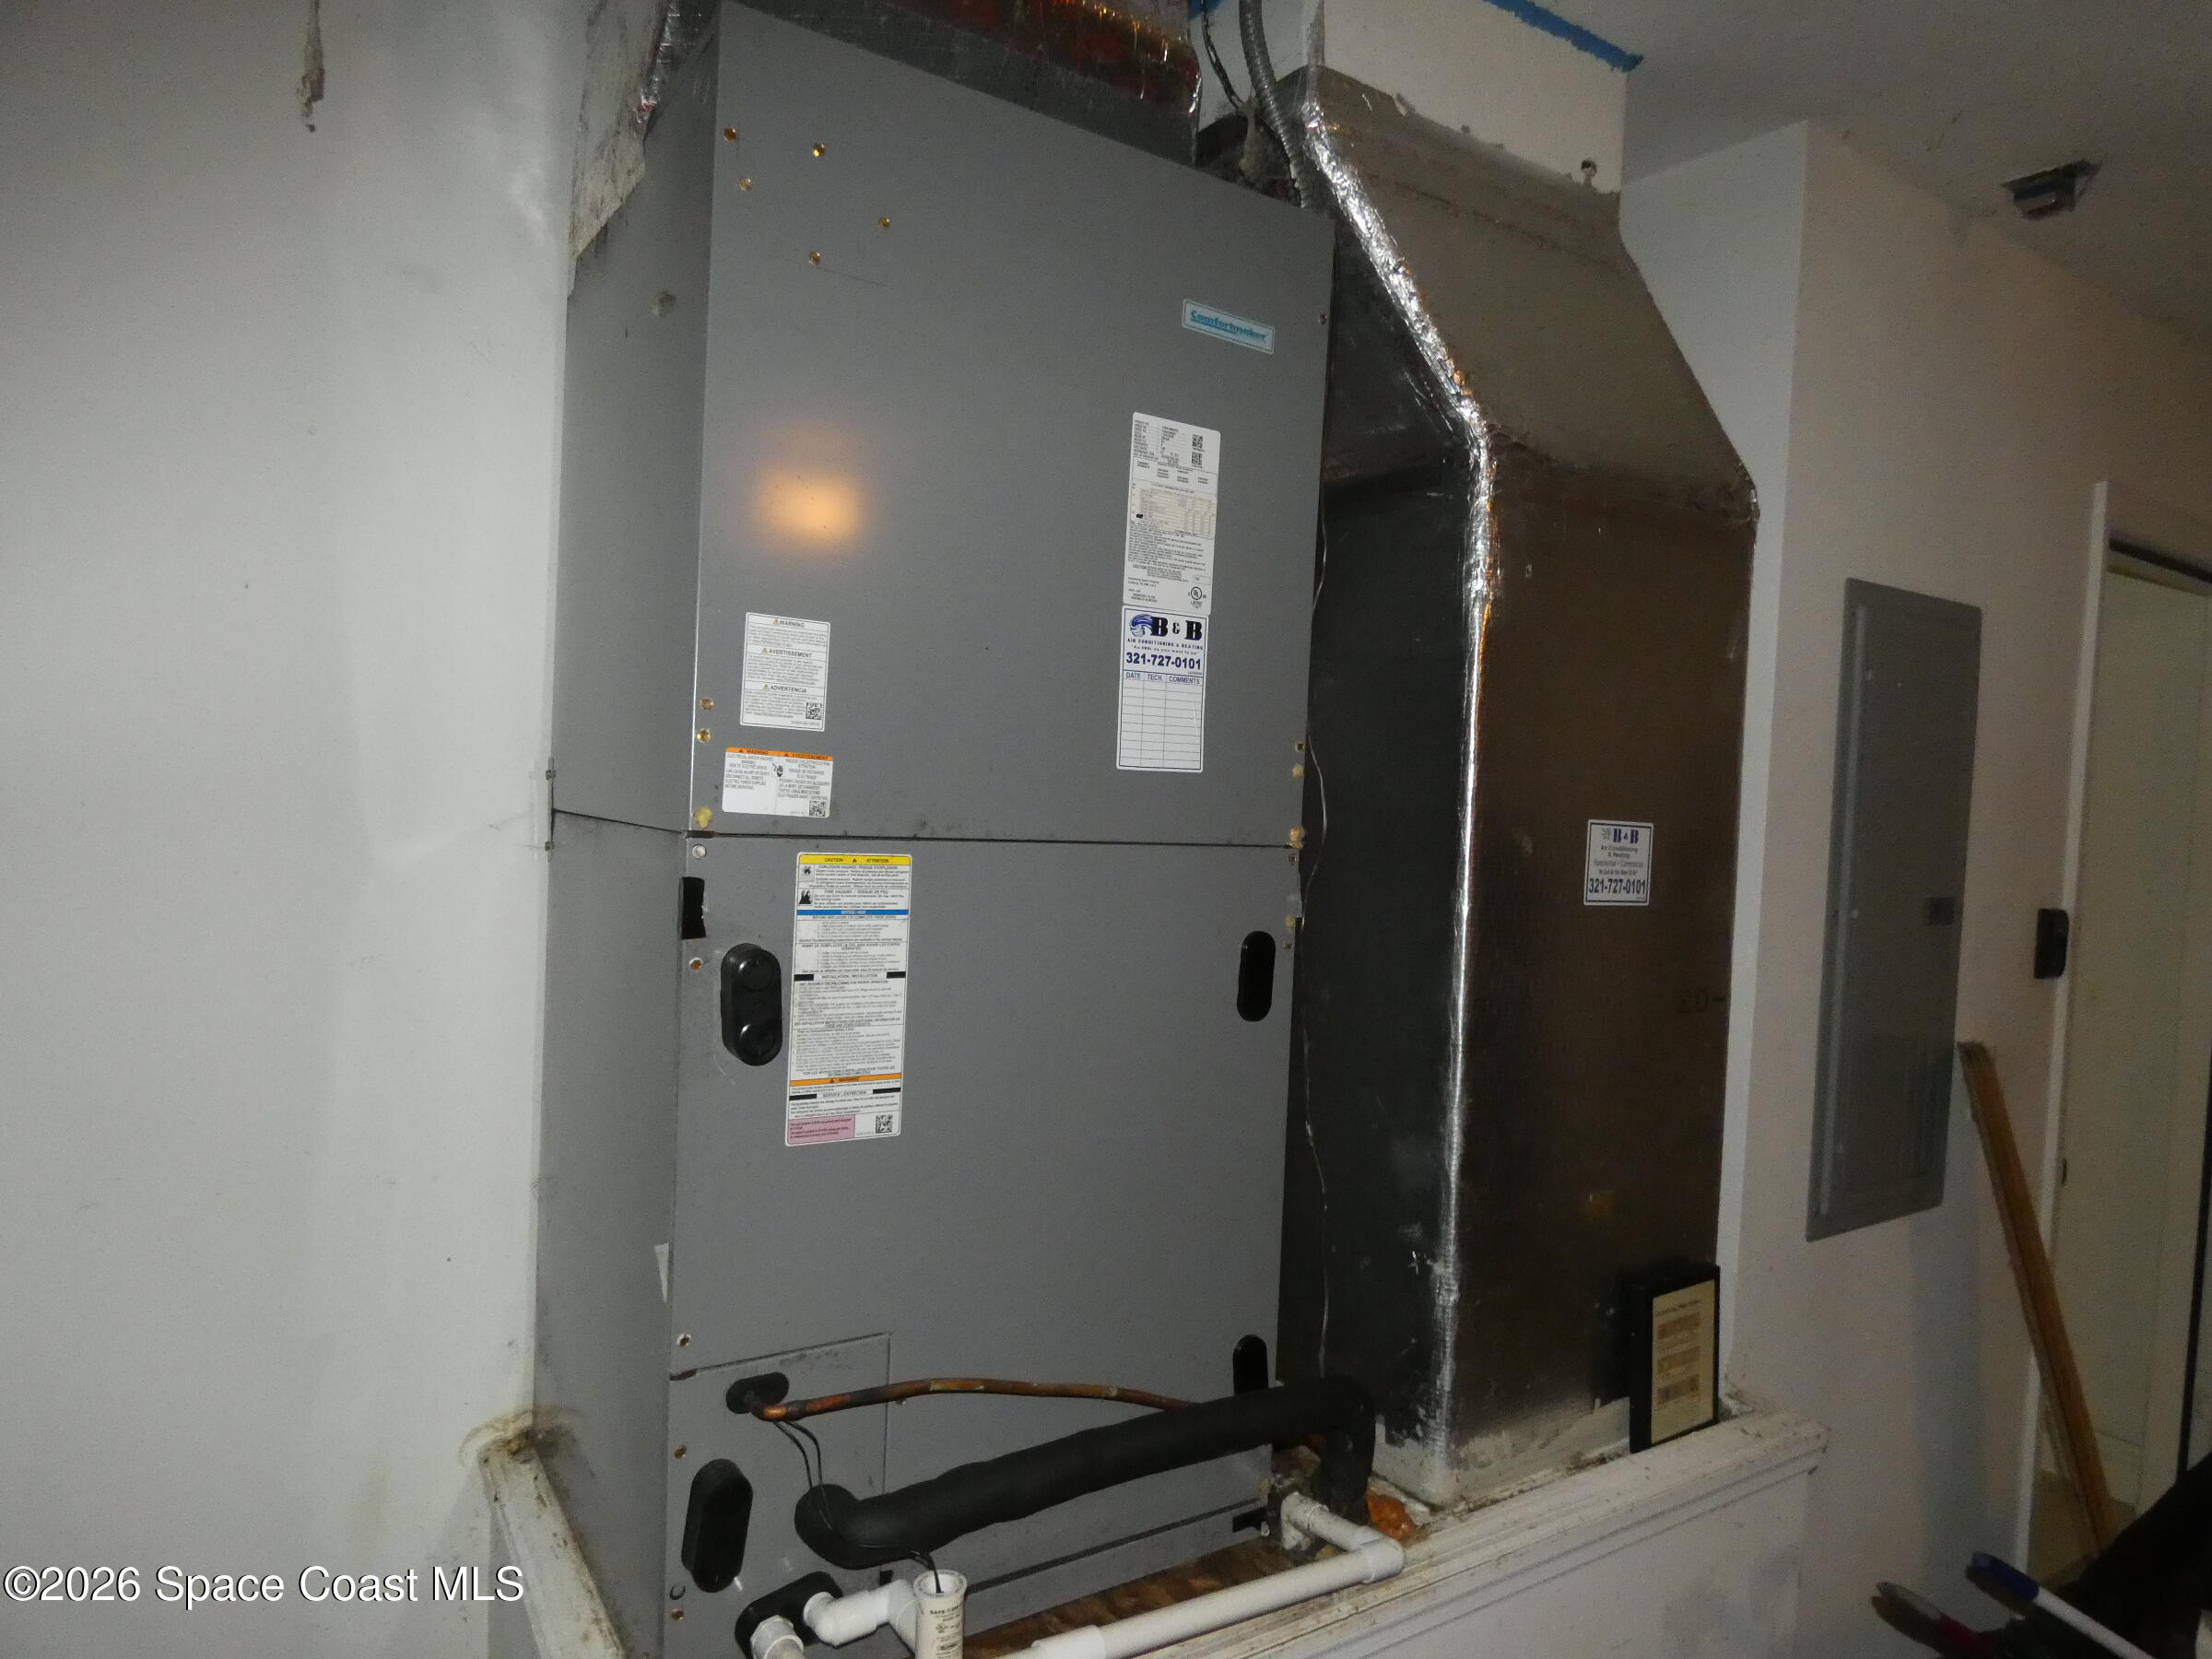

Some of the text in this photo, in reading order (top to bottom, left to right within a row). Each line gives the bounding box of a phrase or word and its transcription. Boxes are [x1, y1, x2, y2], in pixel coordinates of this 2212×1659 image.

[1150, 616, 1203, 641] B & B
[1137, 639, 1174, 647] CONDITIONING
[769, 649, 812, 659] AVERTISSEMENT
[1125, 652, 1201, 670] 321-727-0101
[1169, 676, 1200, 685] COMMENTS
[770, 685, 807, 694] ADVERTENCIA
[1630, 830, 1639, 843] B
[1588, 877, 1646, 894] 321-727-0101
